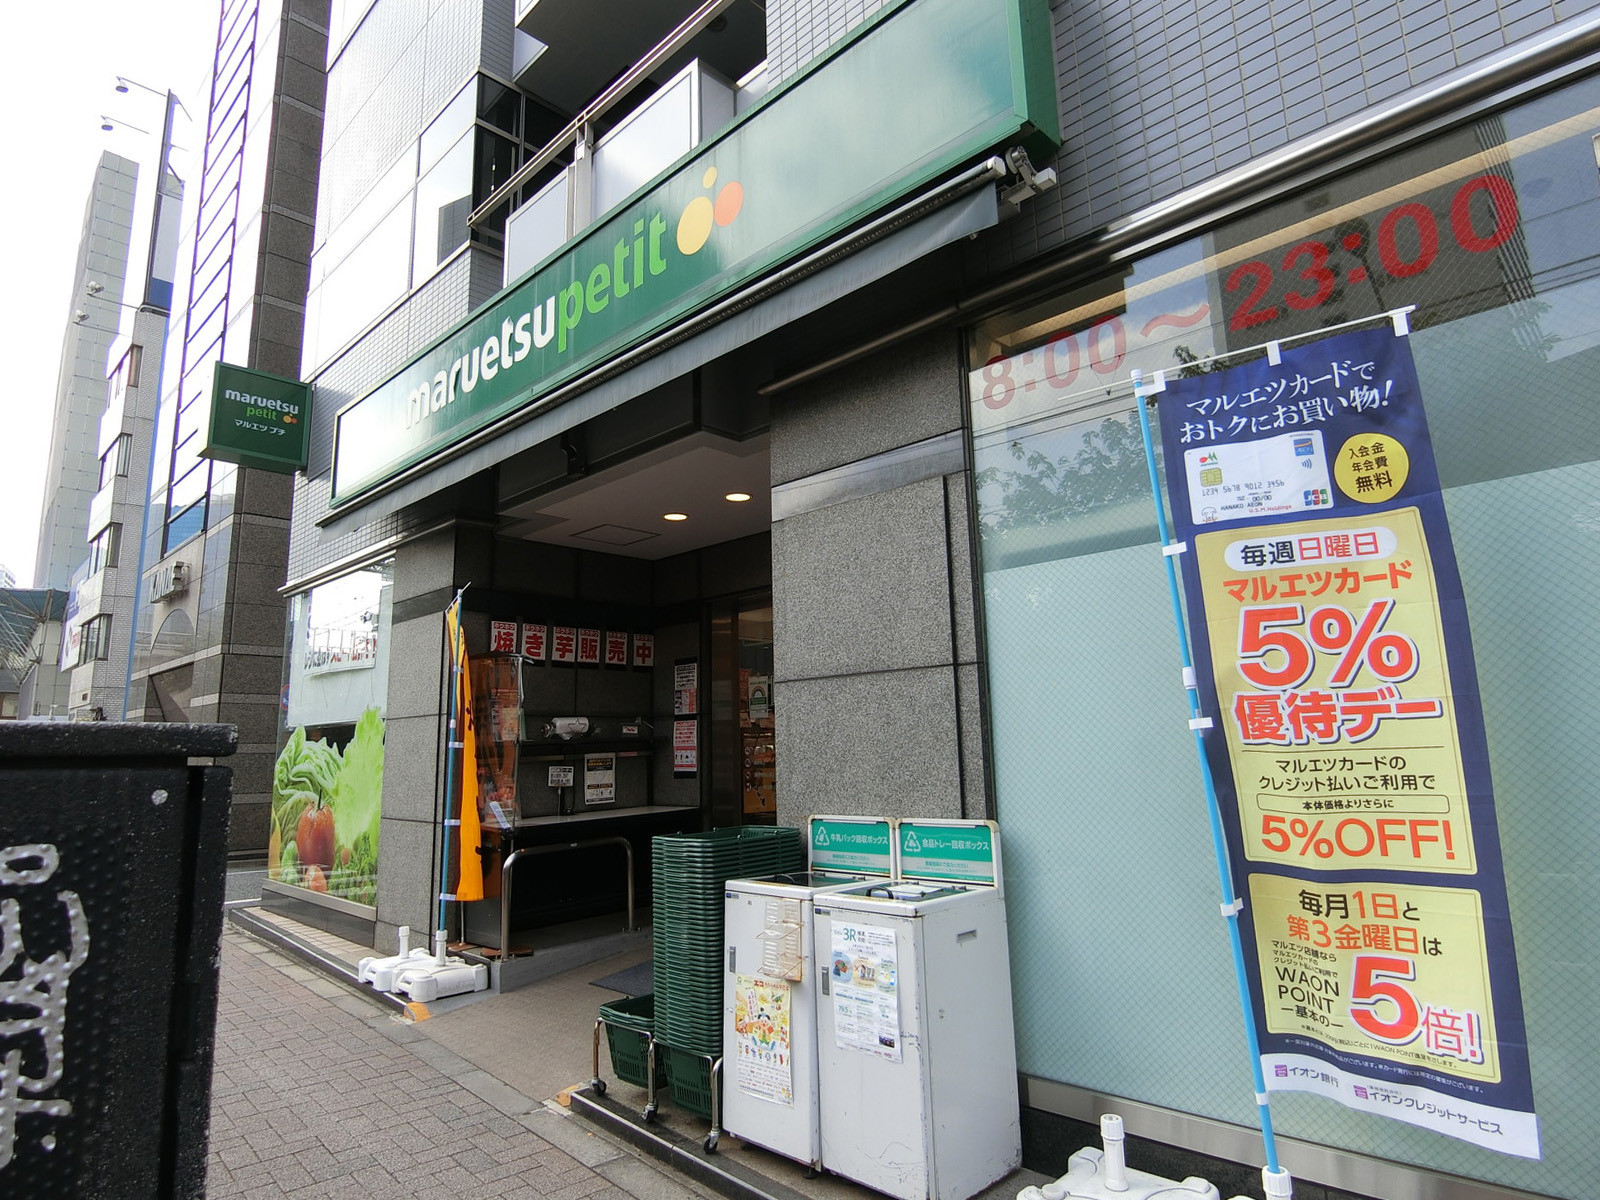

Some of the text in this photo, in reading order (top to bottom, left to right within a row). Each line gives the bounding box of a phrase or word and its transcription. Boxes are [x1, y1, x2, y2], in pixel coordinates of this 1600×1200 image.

[1186, 360, 1375, 416] マルエツカードで
[225, 389, 299, 414] maruetsu
[246, 406, 278, 420] petit
[1349, 442, 1385, 460] 入会金
[1351, 455, 1389, 474] 年会費
[1201, 487, 1219, 497] 1234
[1223, 484, 1242, 494] 5678
[1244, 481, 1263, 491] 9012
[1267, 479, 1285, 488] 3456
[1355, 469, 1393, 494] 無料
[1221, 503, 1244, 511] HANAKO
[1241, 531, 1379, 567] 毎週日曜日
[1223, 560, 1413, 602] マルエツカード
[1239, 600, 1416, 688] 5%
[1235, 687, 1438, 742] 優待デー
[1275, 755, 1407, 774] マルエツカードの
[1258, 774, 1436, 793] クレジット払いご利用で
[1302, 799, 1395, 811] 本体価格よりさらに
[830, 832, 889, 846] 牛乳パック回収ボックス
[922, 838, 990, 851] 食品トレー回収ボックス
[1261, 814, 1456, 860] 5%OFF!
[1298, 889, 1420, 922] 毎月1日と
[1286, 914, 1443, 957] 第3金曜日は
[1271, 939, 1338, 963] マルエツ店舗なら
[1274, 965, 1340, 997] WAON
[1277, 984, 1335, 1014] POINT
[1289, 1066, 1339, 1088] イオン銀行
[1369, 1091, 1504, 1136] イオンクレジットサービス
